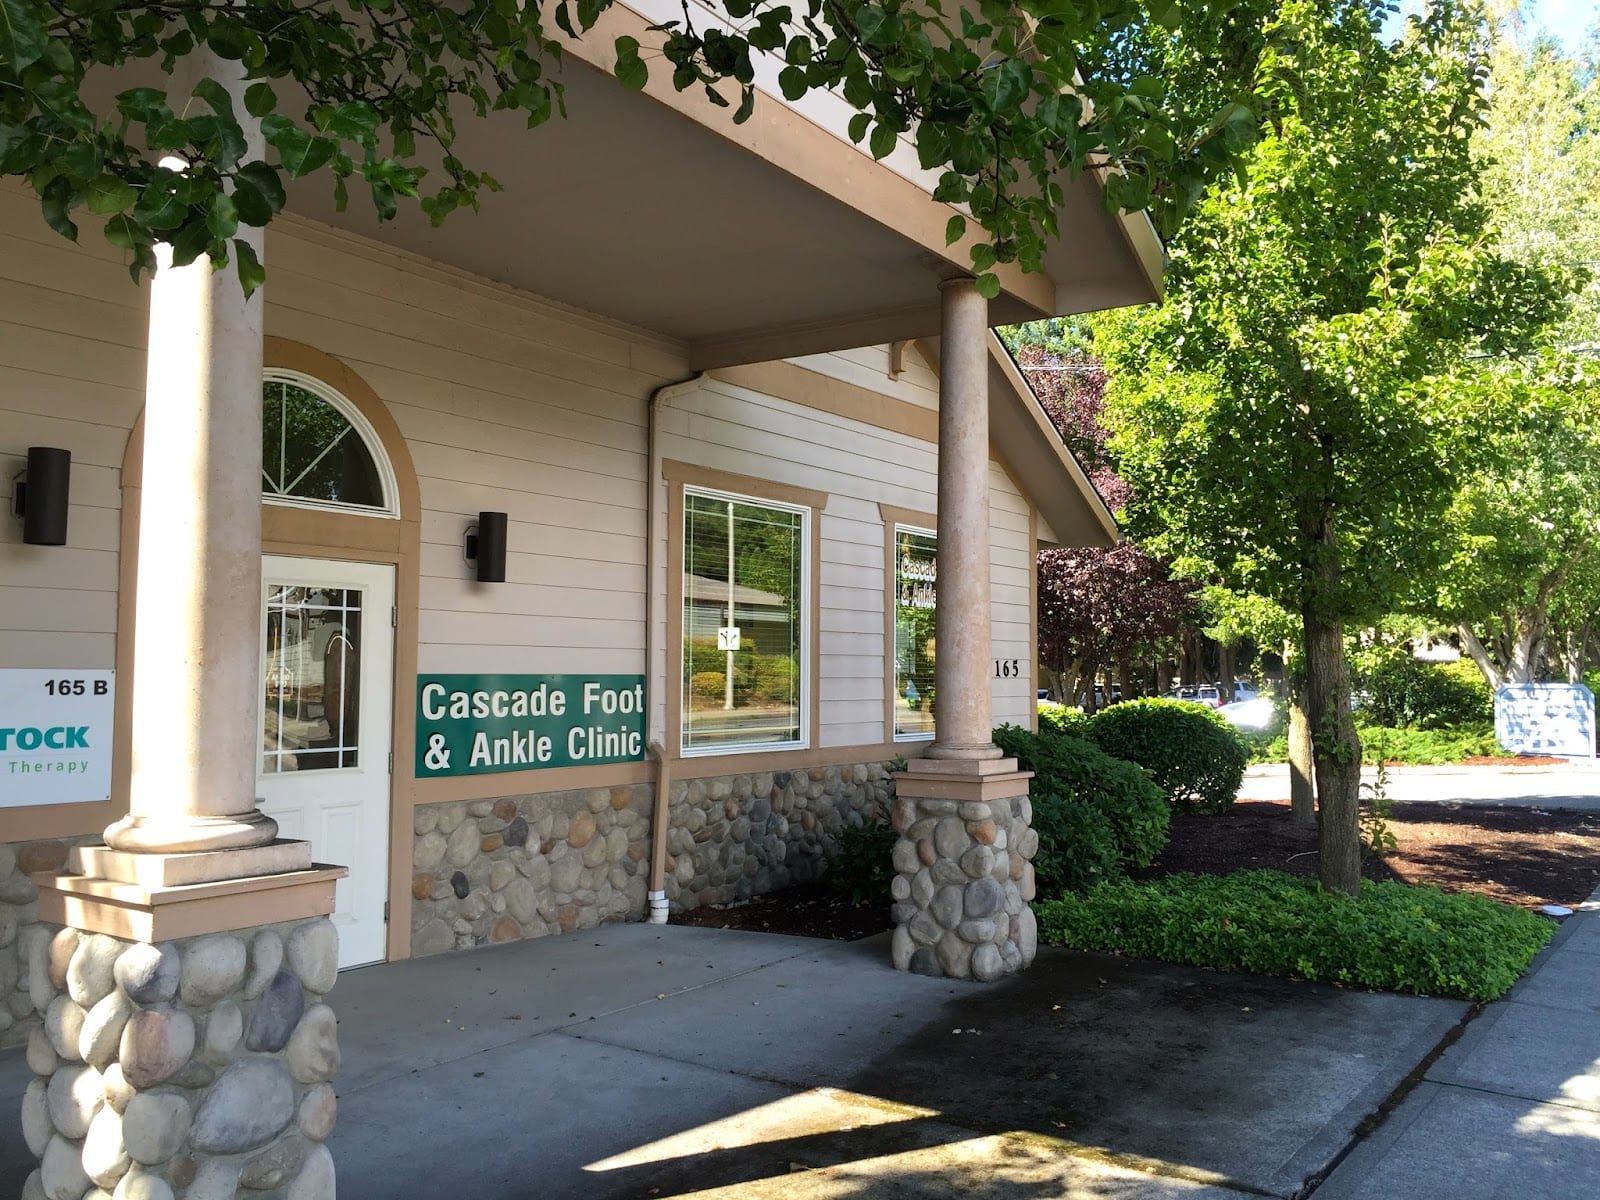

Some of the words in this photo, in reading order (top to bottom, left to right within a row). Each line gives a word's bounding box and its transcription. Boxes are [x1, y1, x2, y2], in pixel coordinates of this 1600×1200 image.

[901, 553, 937, 580] Cascad
[995, 659, 1019, 678] 165
[44, 679, 86, 696] 165
[93, 679, 109, 696] B
[421, 683, 566, 721] Cascade
[583, 683, 644, 715] Foot
[0, 725, 91, 751] TOCK
[424, 733, 451, 770] &
[469, 730, 552, 768] Ankle
[567, 725, 642, 760] Clinic
[8, 760, 89, 774] Therapy
